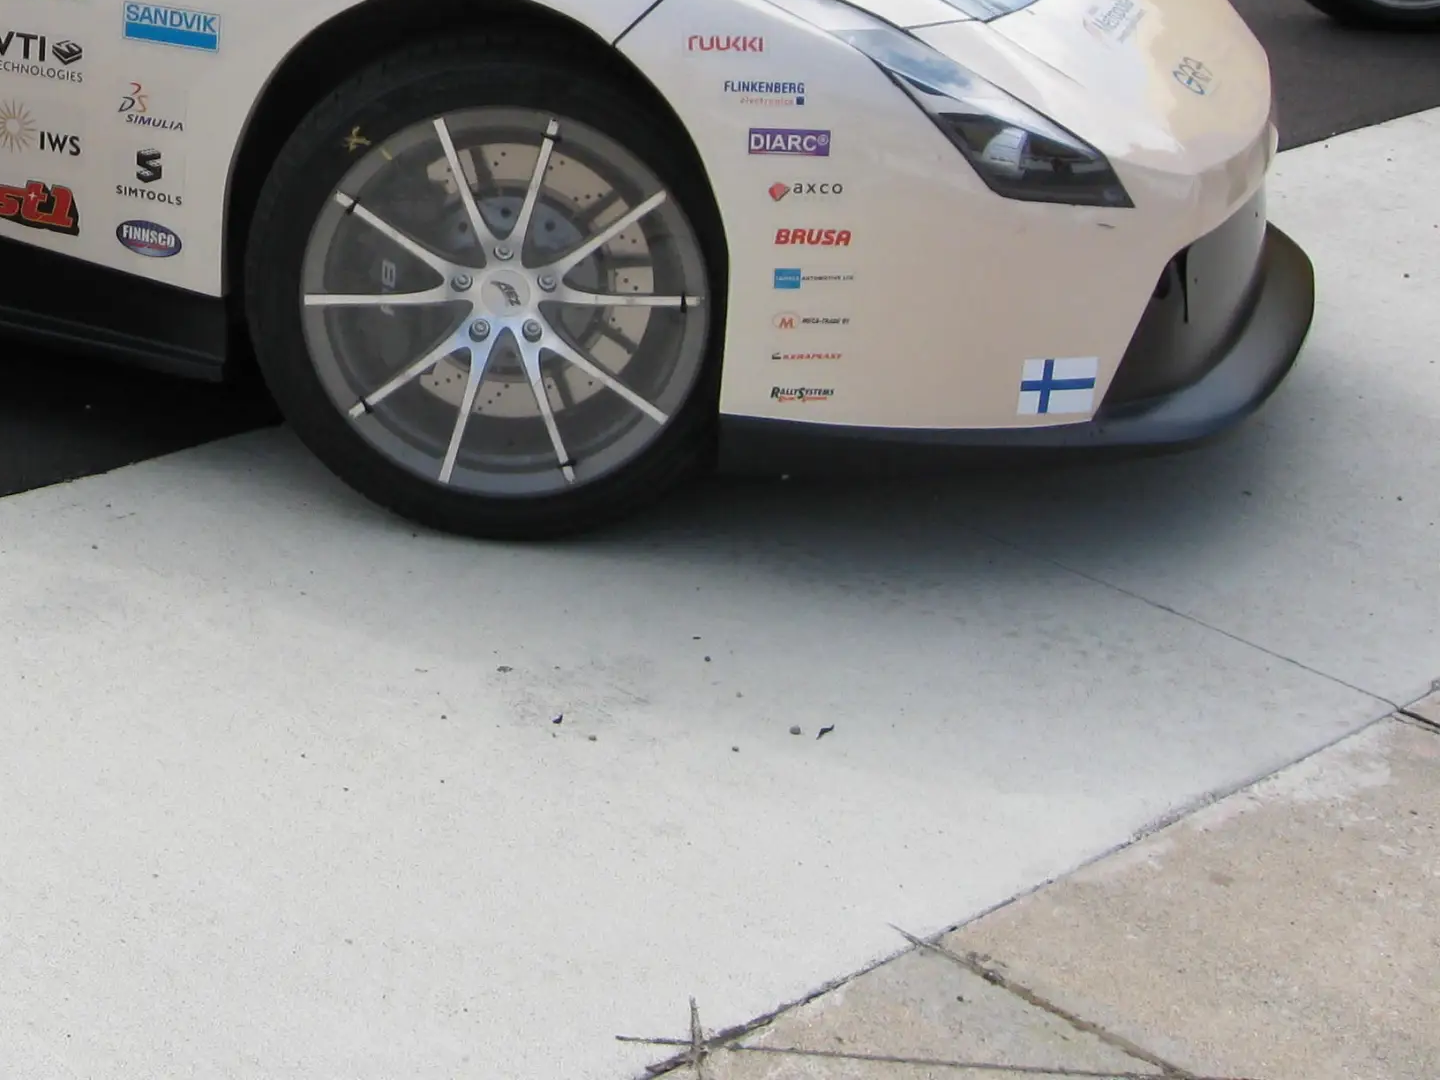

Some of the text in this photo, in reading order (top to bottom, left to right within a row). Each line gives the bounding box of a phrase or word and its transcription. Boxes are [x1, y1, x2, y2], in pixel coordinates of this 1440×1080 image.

[126, 4, 218, 33] SANDVIK
[724, 80, 806, 94] FLINKENBERG
[126, 113, 184, 132] SIMULIA
[39, 131, 81, 157] IWS
[116, 185, 182, 206] SIMTOOLS
[793, 183, 843, 195] axco
[774, 228, 852, 246] BRUSA
